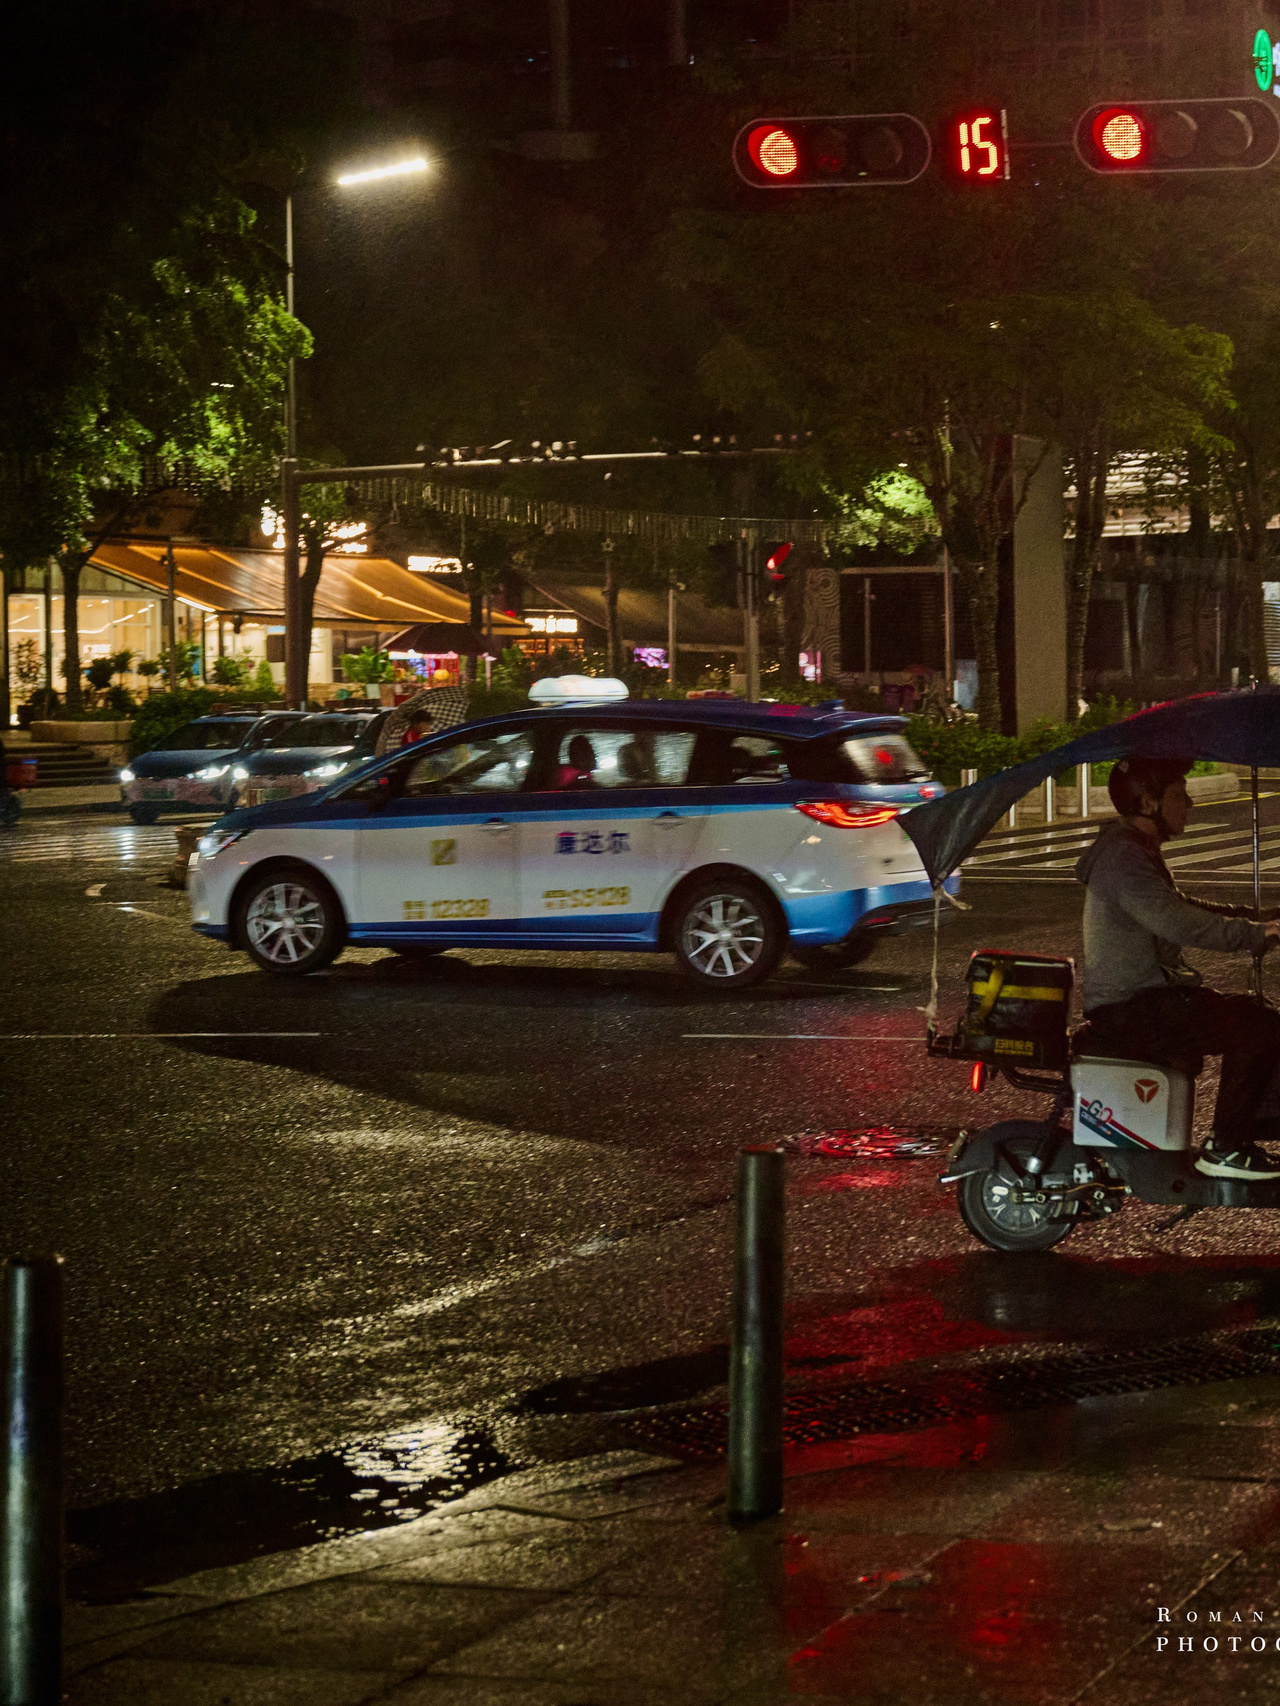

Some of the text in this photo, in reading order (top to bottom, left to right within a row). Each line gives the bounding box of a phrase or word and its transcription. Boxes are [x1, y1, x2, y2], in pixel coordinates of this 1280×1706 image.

[959, 116, 998, 174] 15
[555, 830, 631, 855] 康达尔
